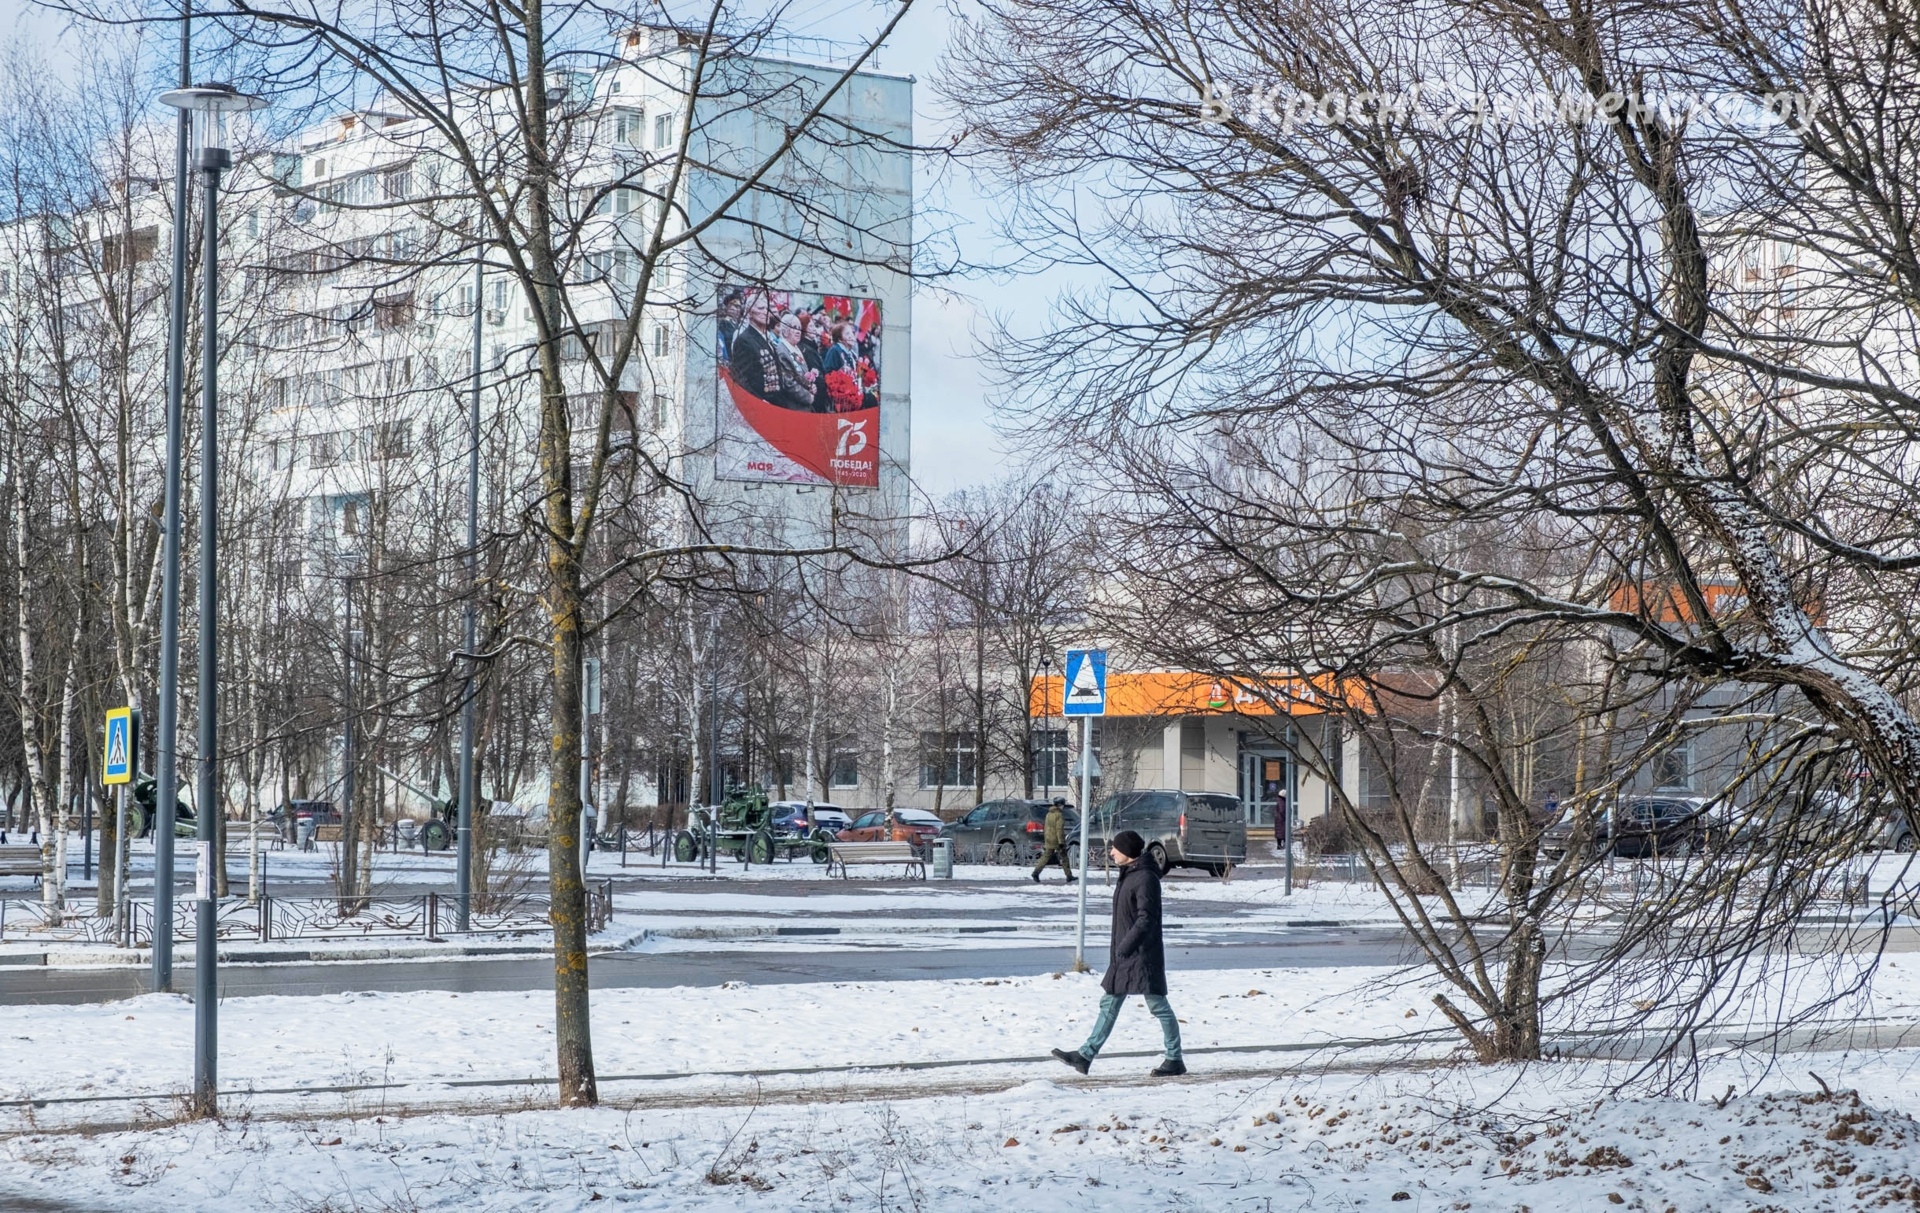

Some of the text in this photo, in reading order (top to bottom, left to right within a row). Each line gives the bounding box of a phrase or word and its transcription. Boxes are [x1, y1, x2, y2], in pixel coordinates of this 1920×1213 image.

[835, 418, 868, 456] 75
[747, 461, 773, 471] мая
[830, 458, 872, 471] ПОБЕДА!
